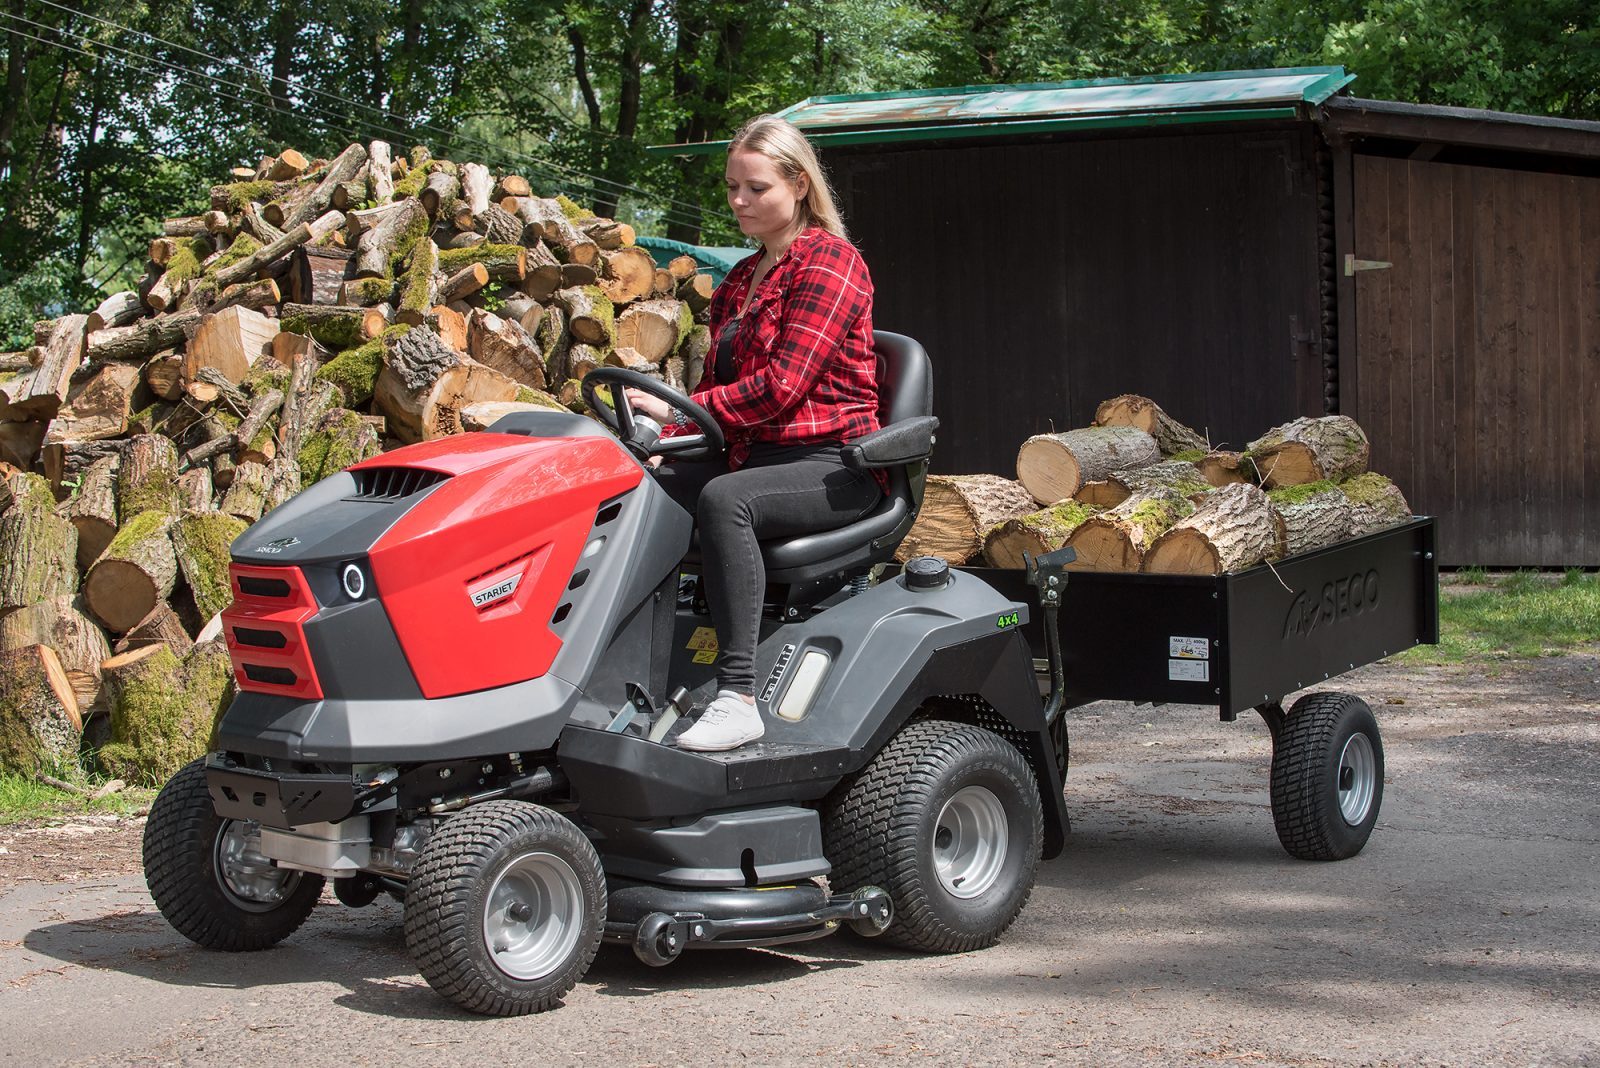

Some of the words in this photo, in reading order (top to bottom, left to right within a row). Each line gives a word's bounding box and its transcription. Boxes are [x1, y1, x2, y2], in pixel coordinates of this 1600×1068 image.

[475, 581, 513, 604] STARJET
[1321, 568, 1380, 626] SECO
[997, 612, 1019, 628] 4x4
